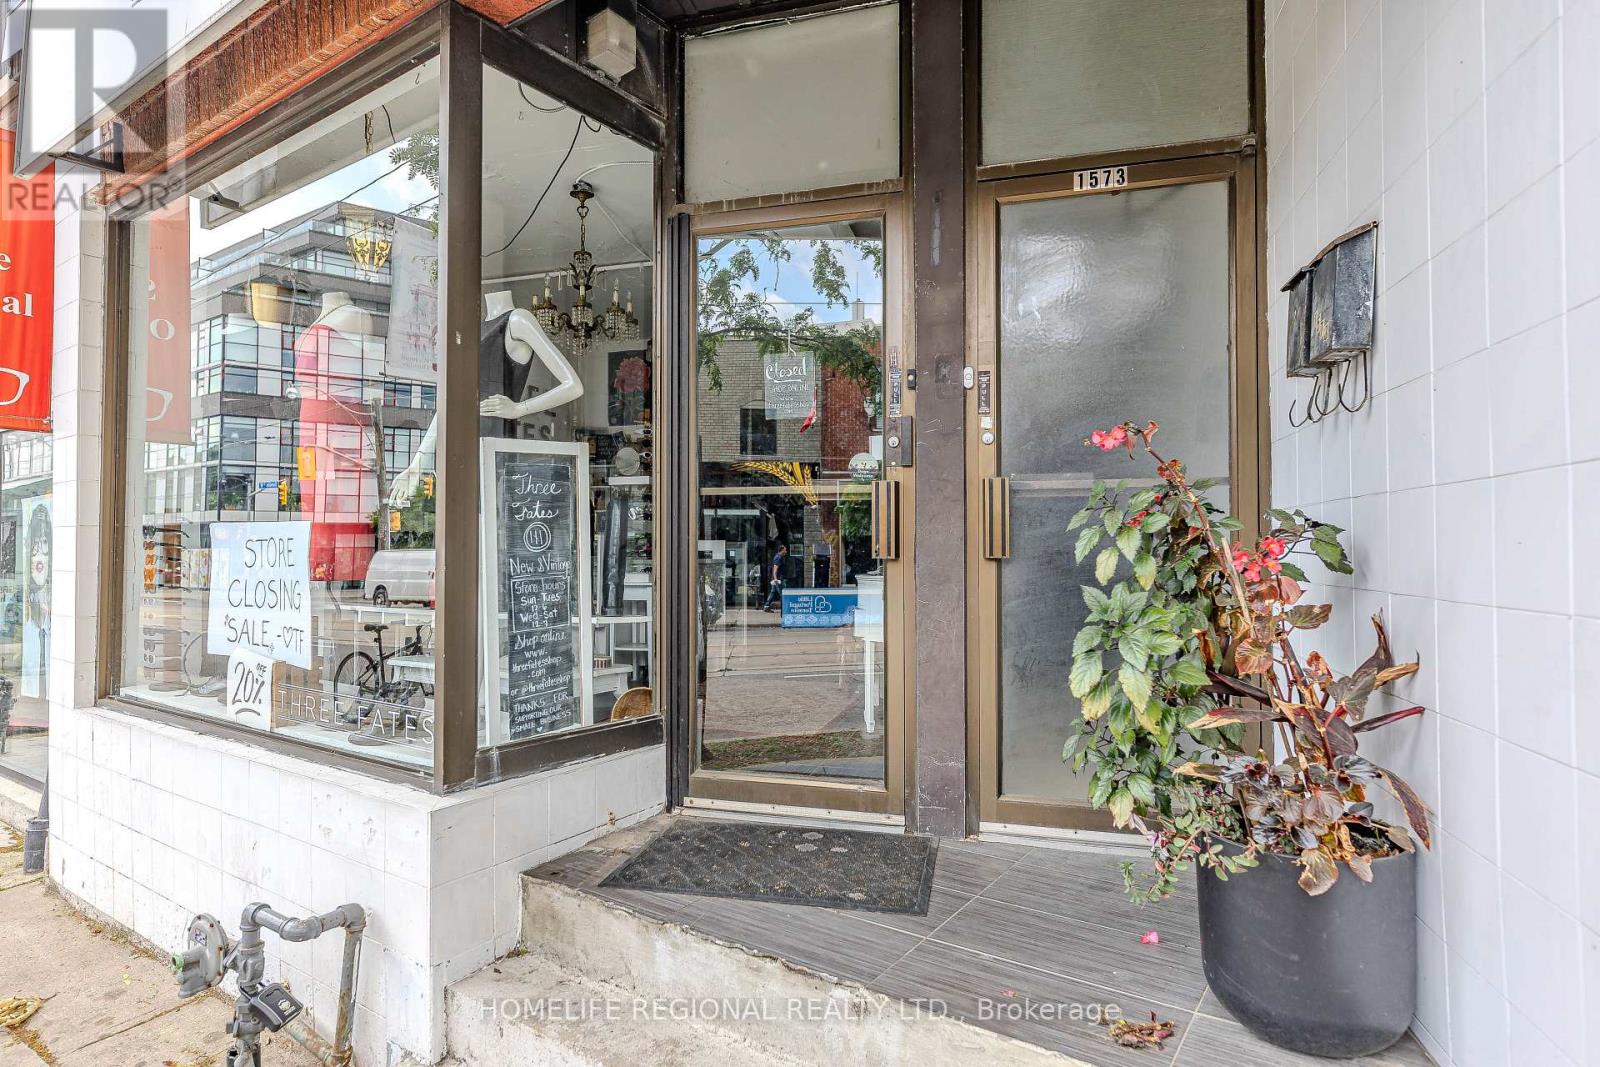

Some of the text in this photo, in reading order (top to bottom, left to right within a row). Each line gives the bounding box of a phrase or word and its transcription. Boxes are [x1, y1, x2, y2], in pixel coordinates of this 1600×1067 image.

[1077, 167, 1126, 190] 1573
[766, 356, 807, 383] Closed
[512, 473, 562, 495] Three
[511, 498, 559, 520] Fates
[244, 536, 295, 569] STORE
[510, 557, 534, 576] New
[227, 577, 302, 613] CLOSING
[515, 579, 566, 595] Store hours
[514, 634, 539, 650] Shop
[231, 661, 266, 706] 20%
[513, 691, 569, 714] THANKS FOR
[549, 704, 563, 714] OUR
[278, 689, 434, 745] THREE FATES
